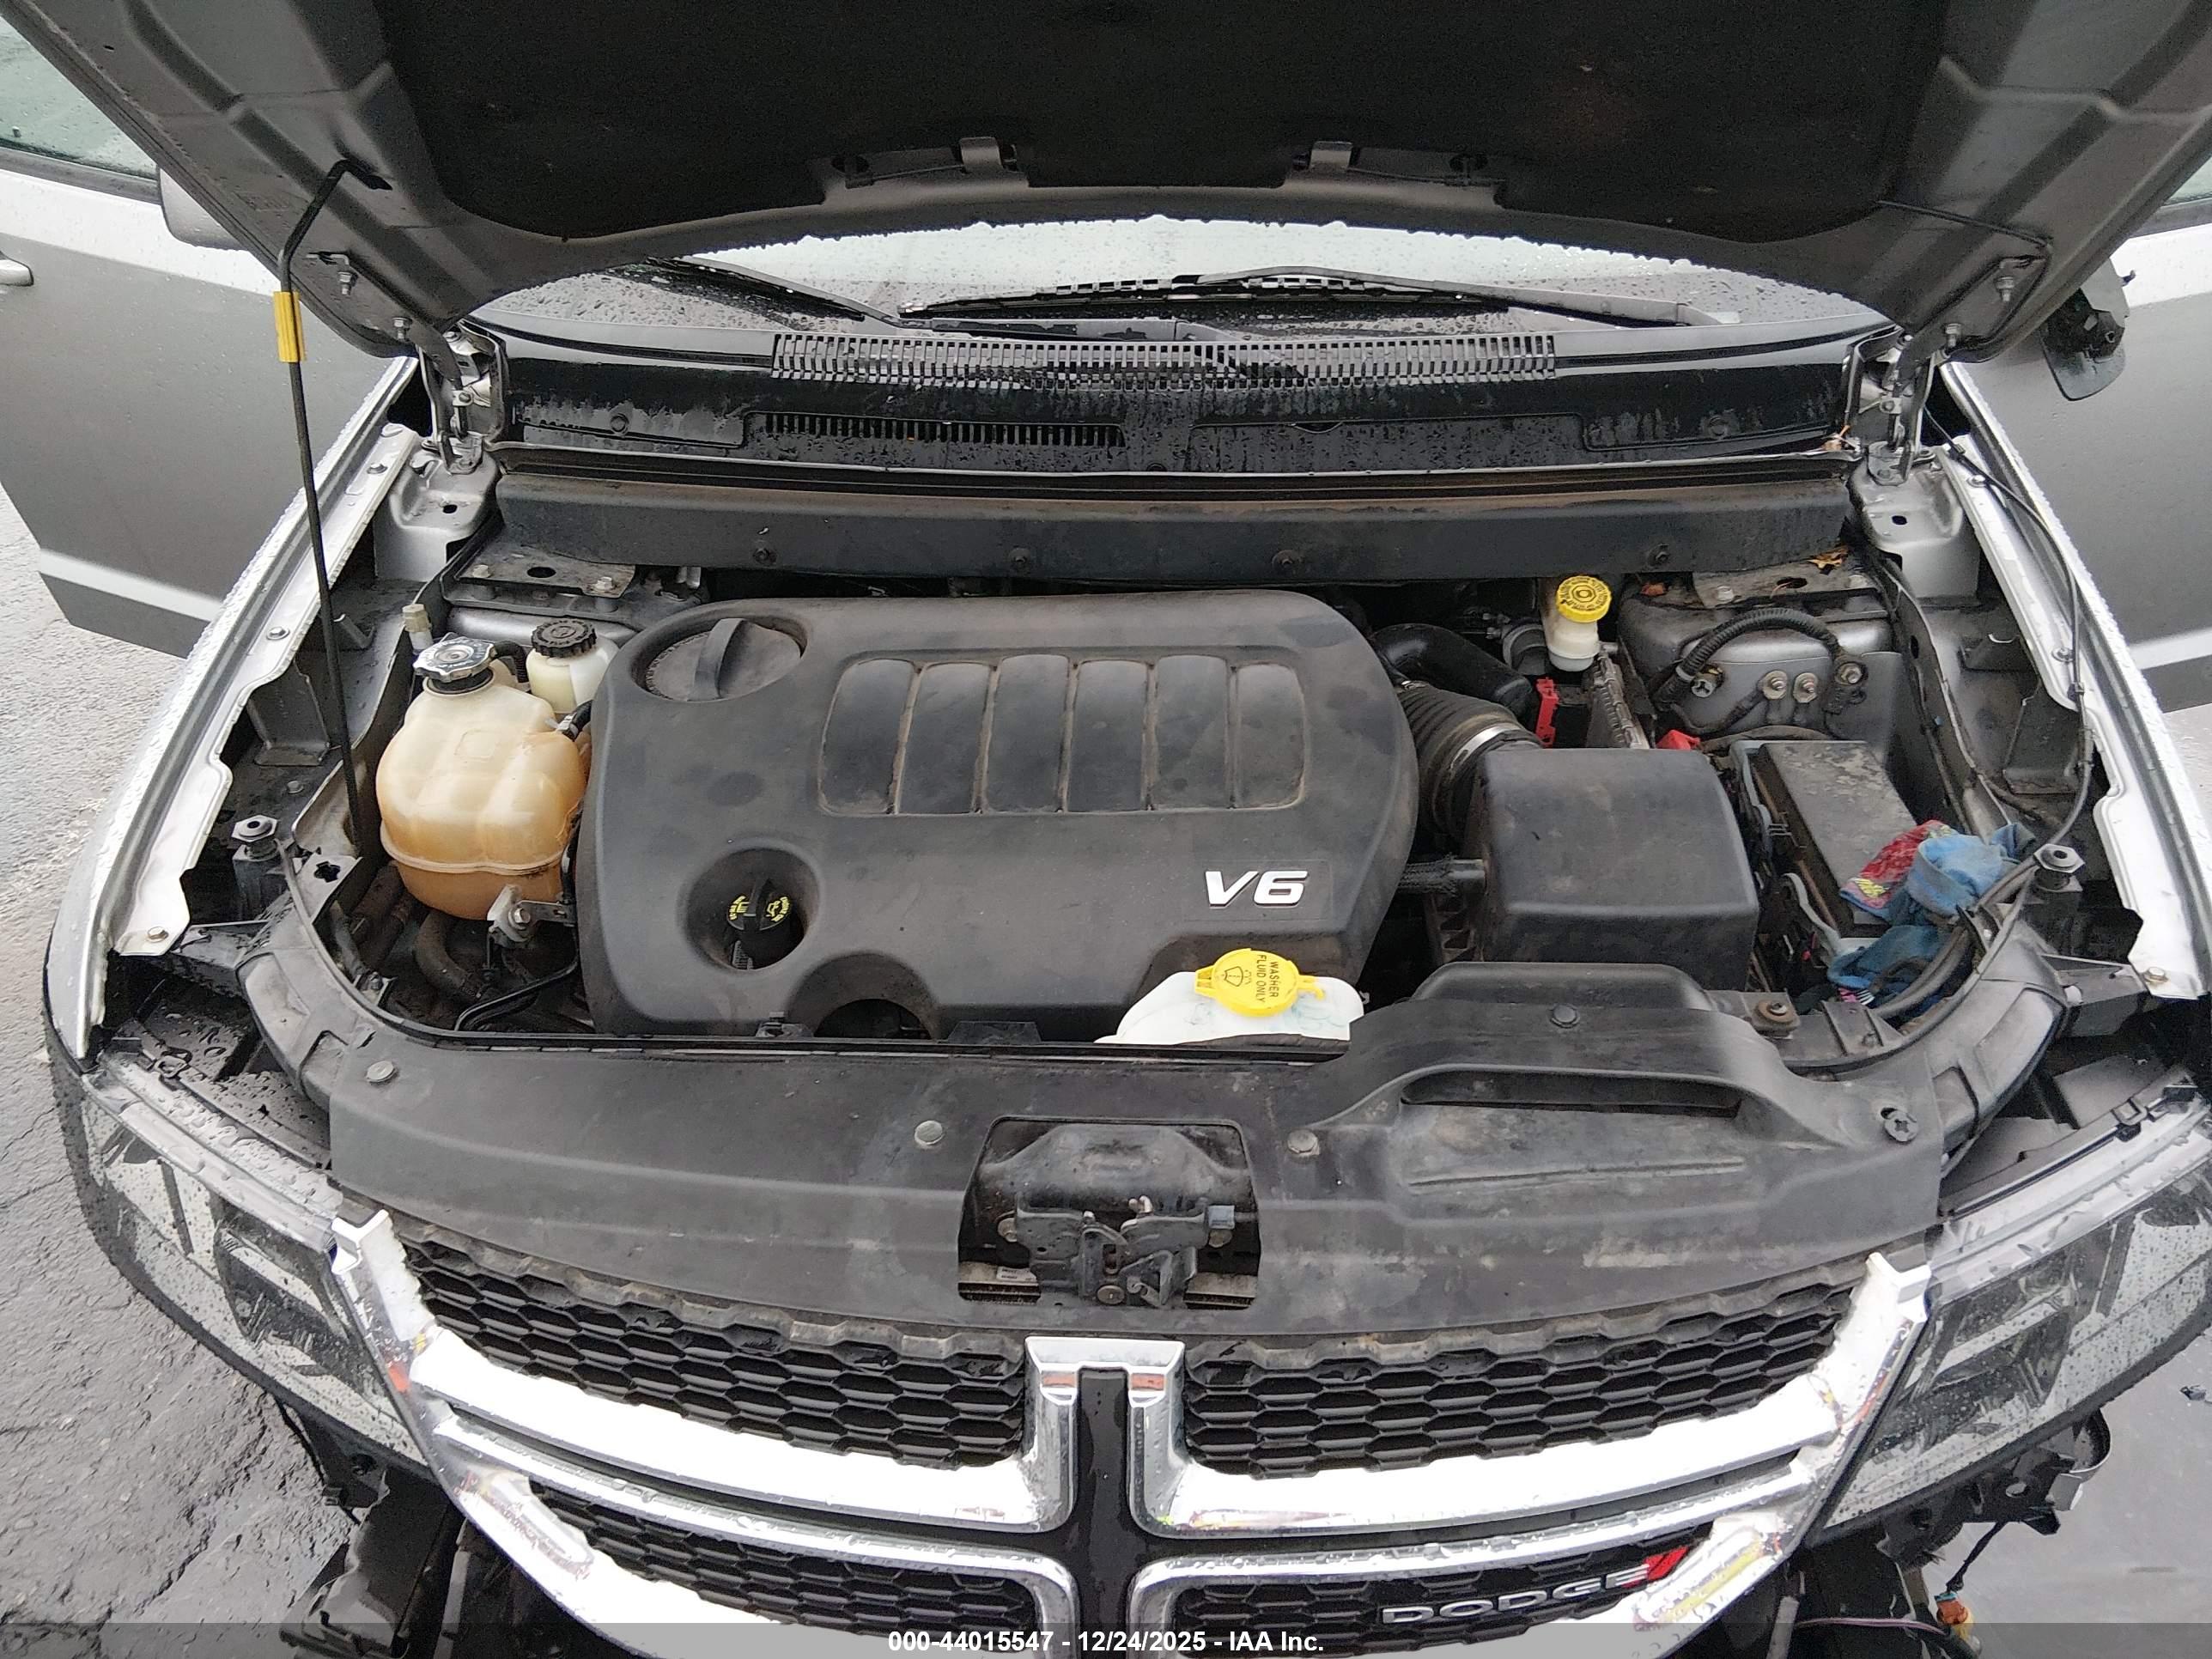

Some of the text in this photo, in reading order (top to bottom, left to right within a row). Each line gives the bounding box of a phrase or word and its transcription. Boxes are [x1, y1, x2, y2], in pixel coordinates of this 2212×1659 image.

[1205, 870, 1309, 906] V6
[1255, 954, 1267, 1003] FLUID ONLY
[1269, 961, 1279, 998] WASHER
[1382, 1563, 1649, 1625] DODGE
